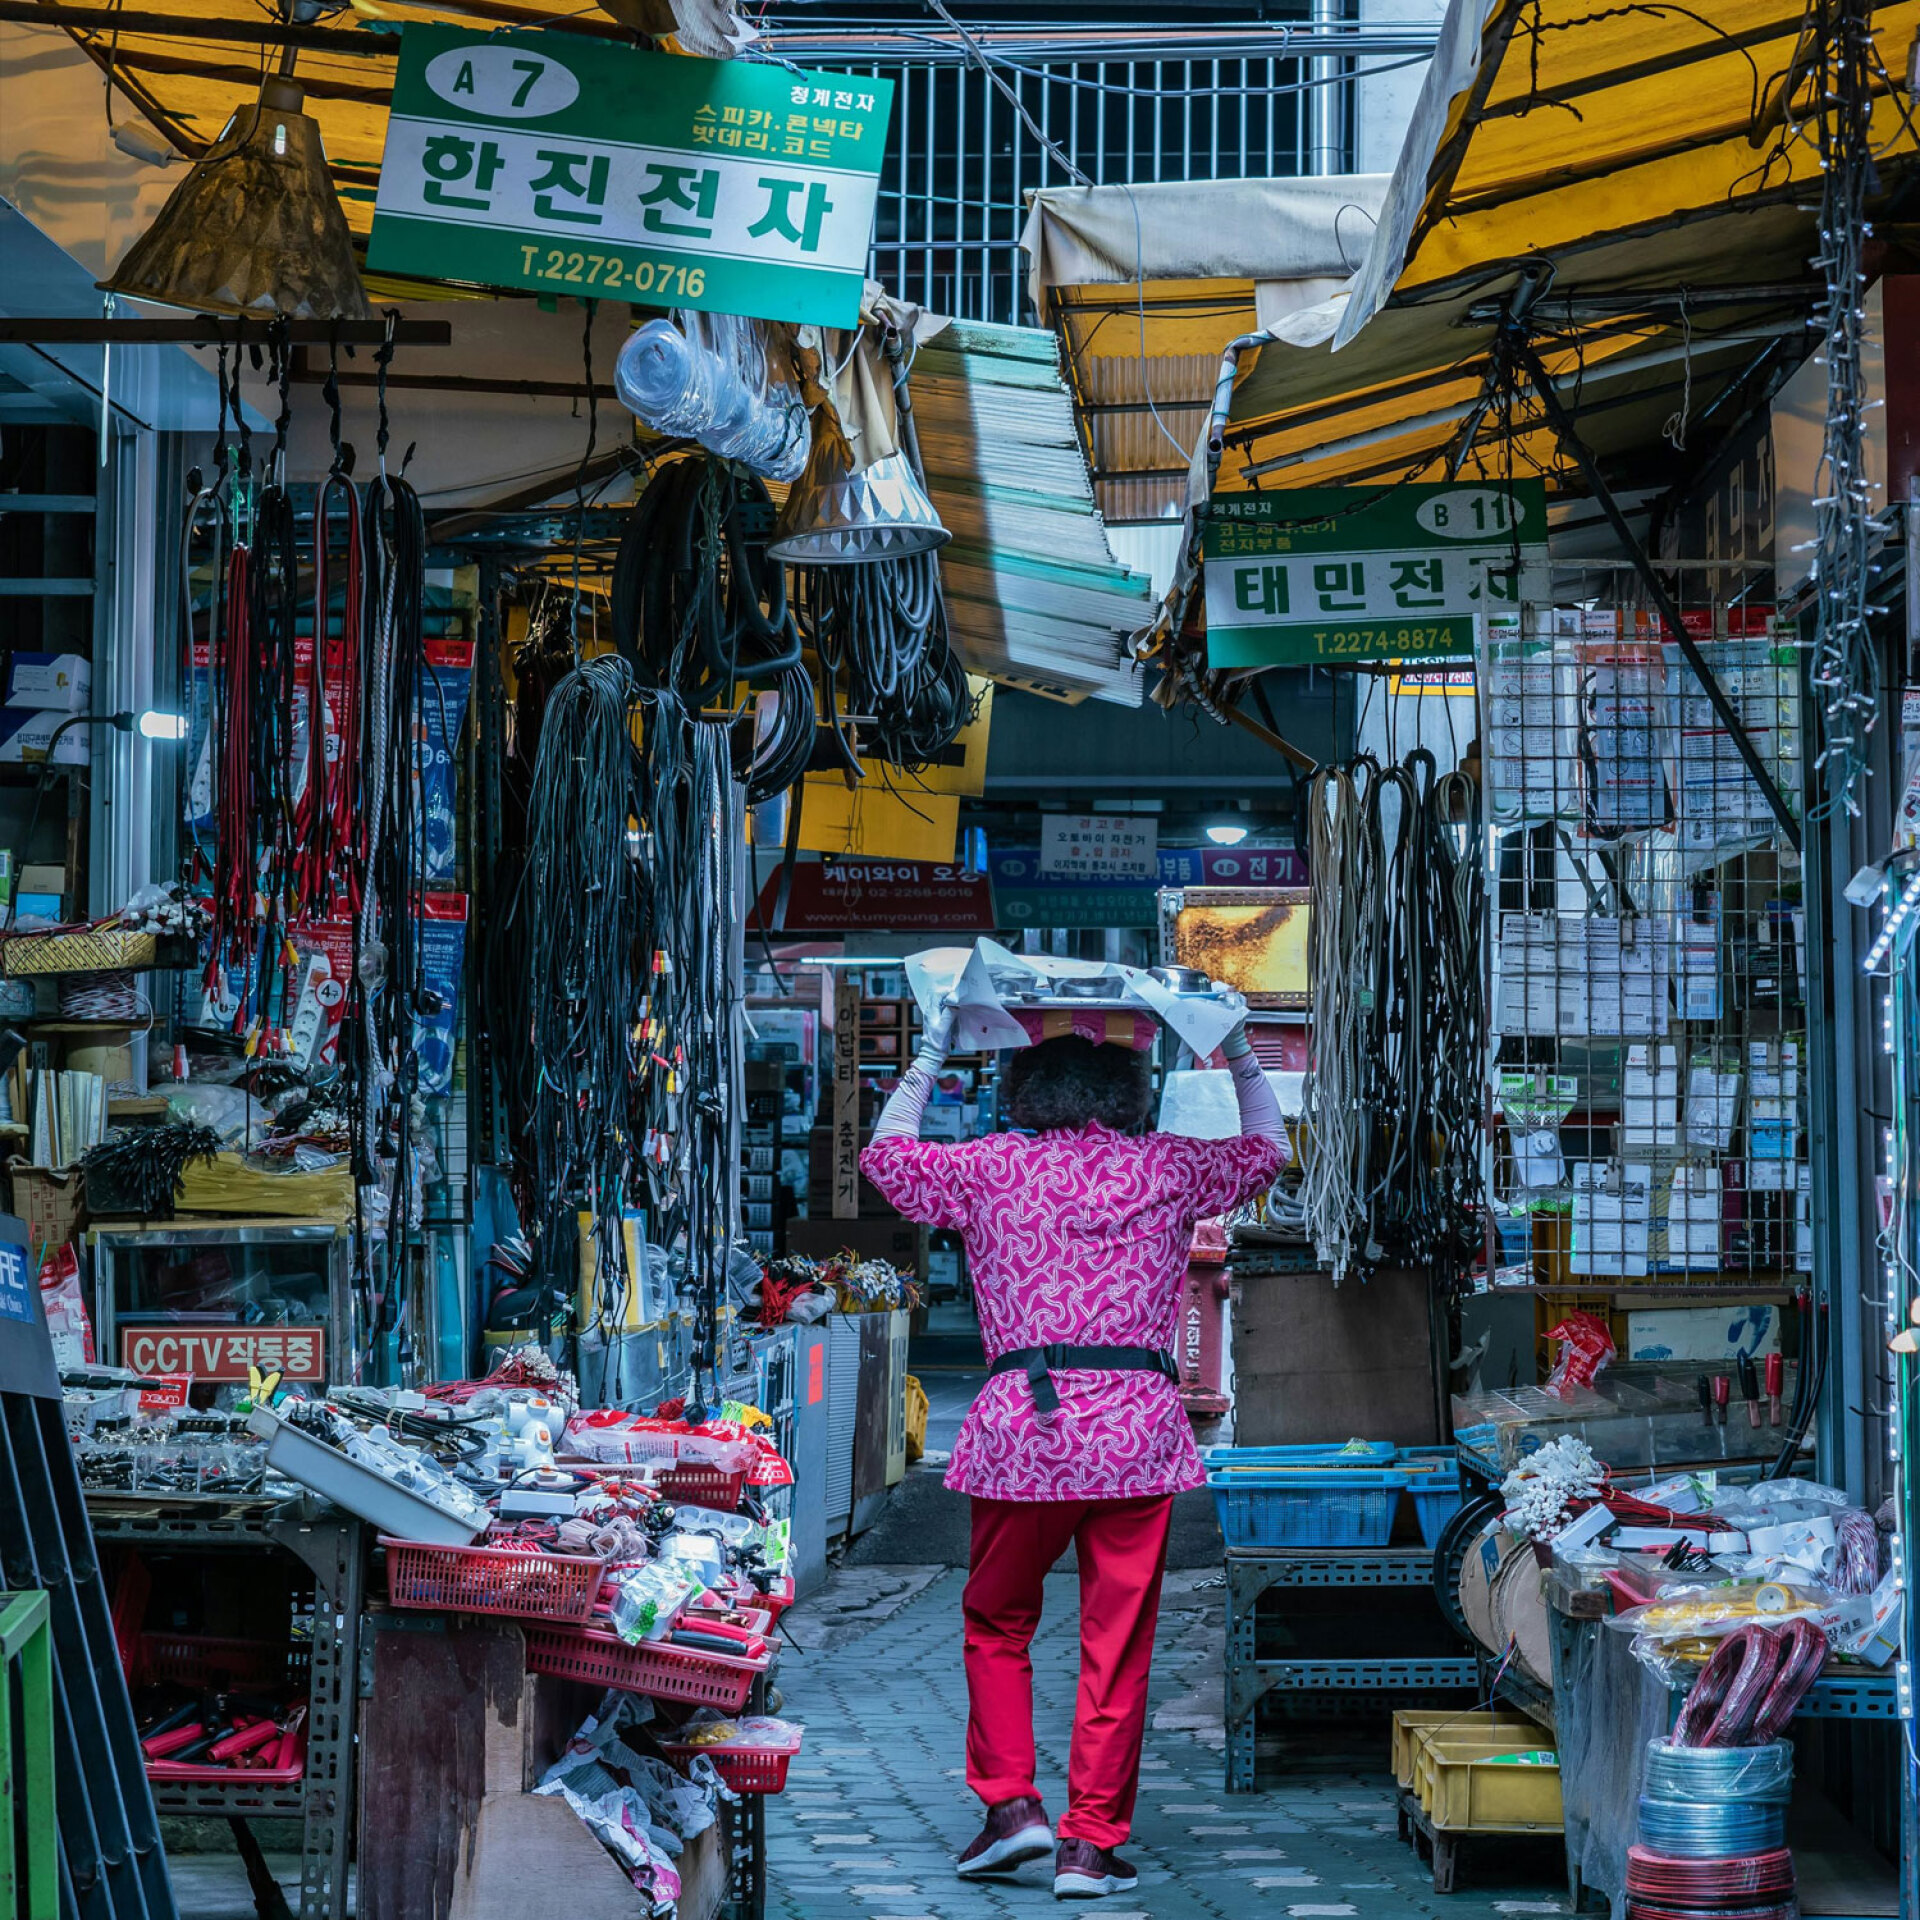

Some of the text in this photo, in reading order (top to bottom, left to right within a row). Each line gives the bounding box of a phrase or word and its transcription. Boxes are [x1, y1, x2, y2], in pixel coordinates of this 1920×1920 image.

[452, 59, 546, 108] A 7
[789, 85, 876, 112] 청계전자
[421, 135, 834, 253] 한진전자
[520, 245, 706, 298] T.2272-0716
[1433, 505, 1449, 527] B
[1234, 554, 1519, 616] 태민전자
[1313, 627, 1454, 655] T.2274-8874
[822, 865, 920, 884] 케이와이
[321, 984, 339, 1000] 4구
